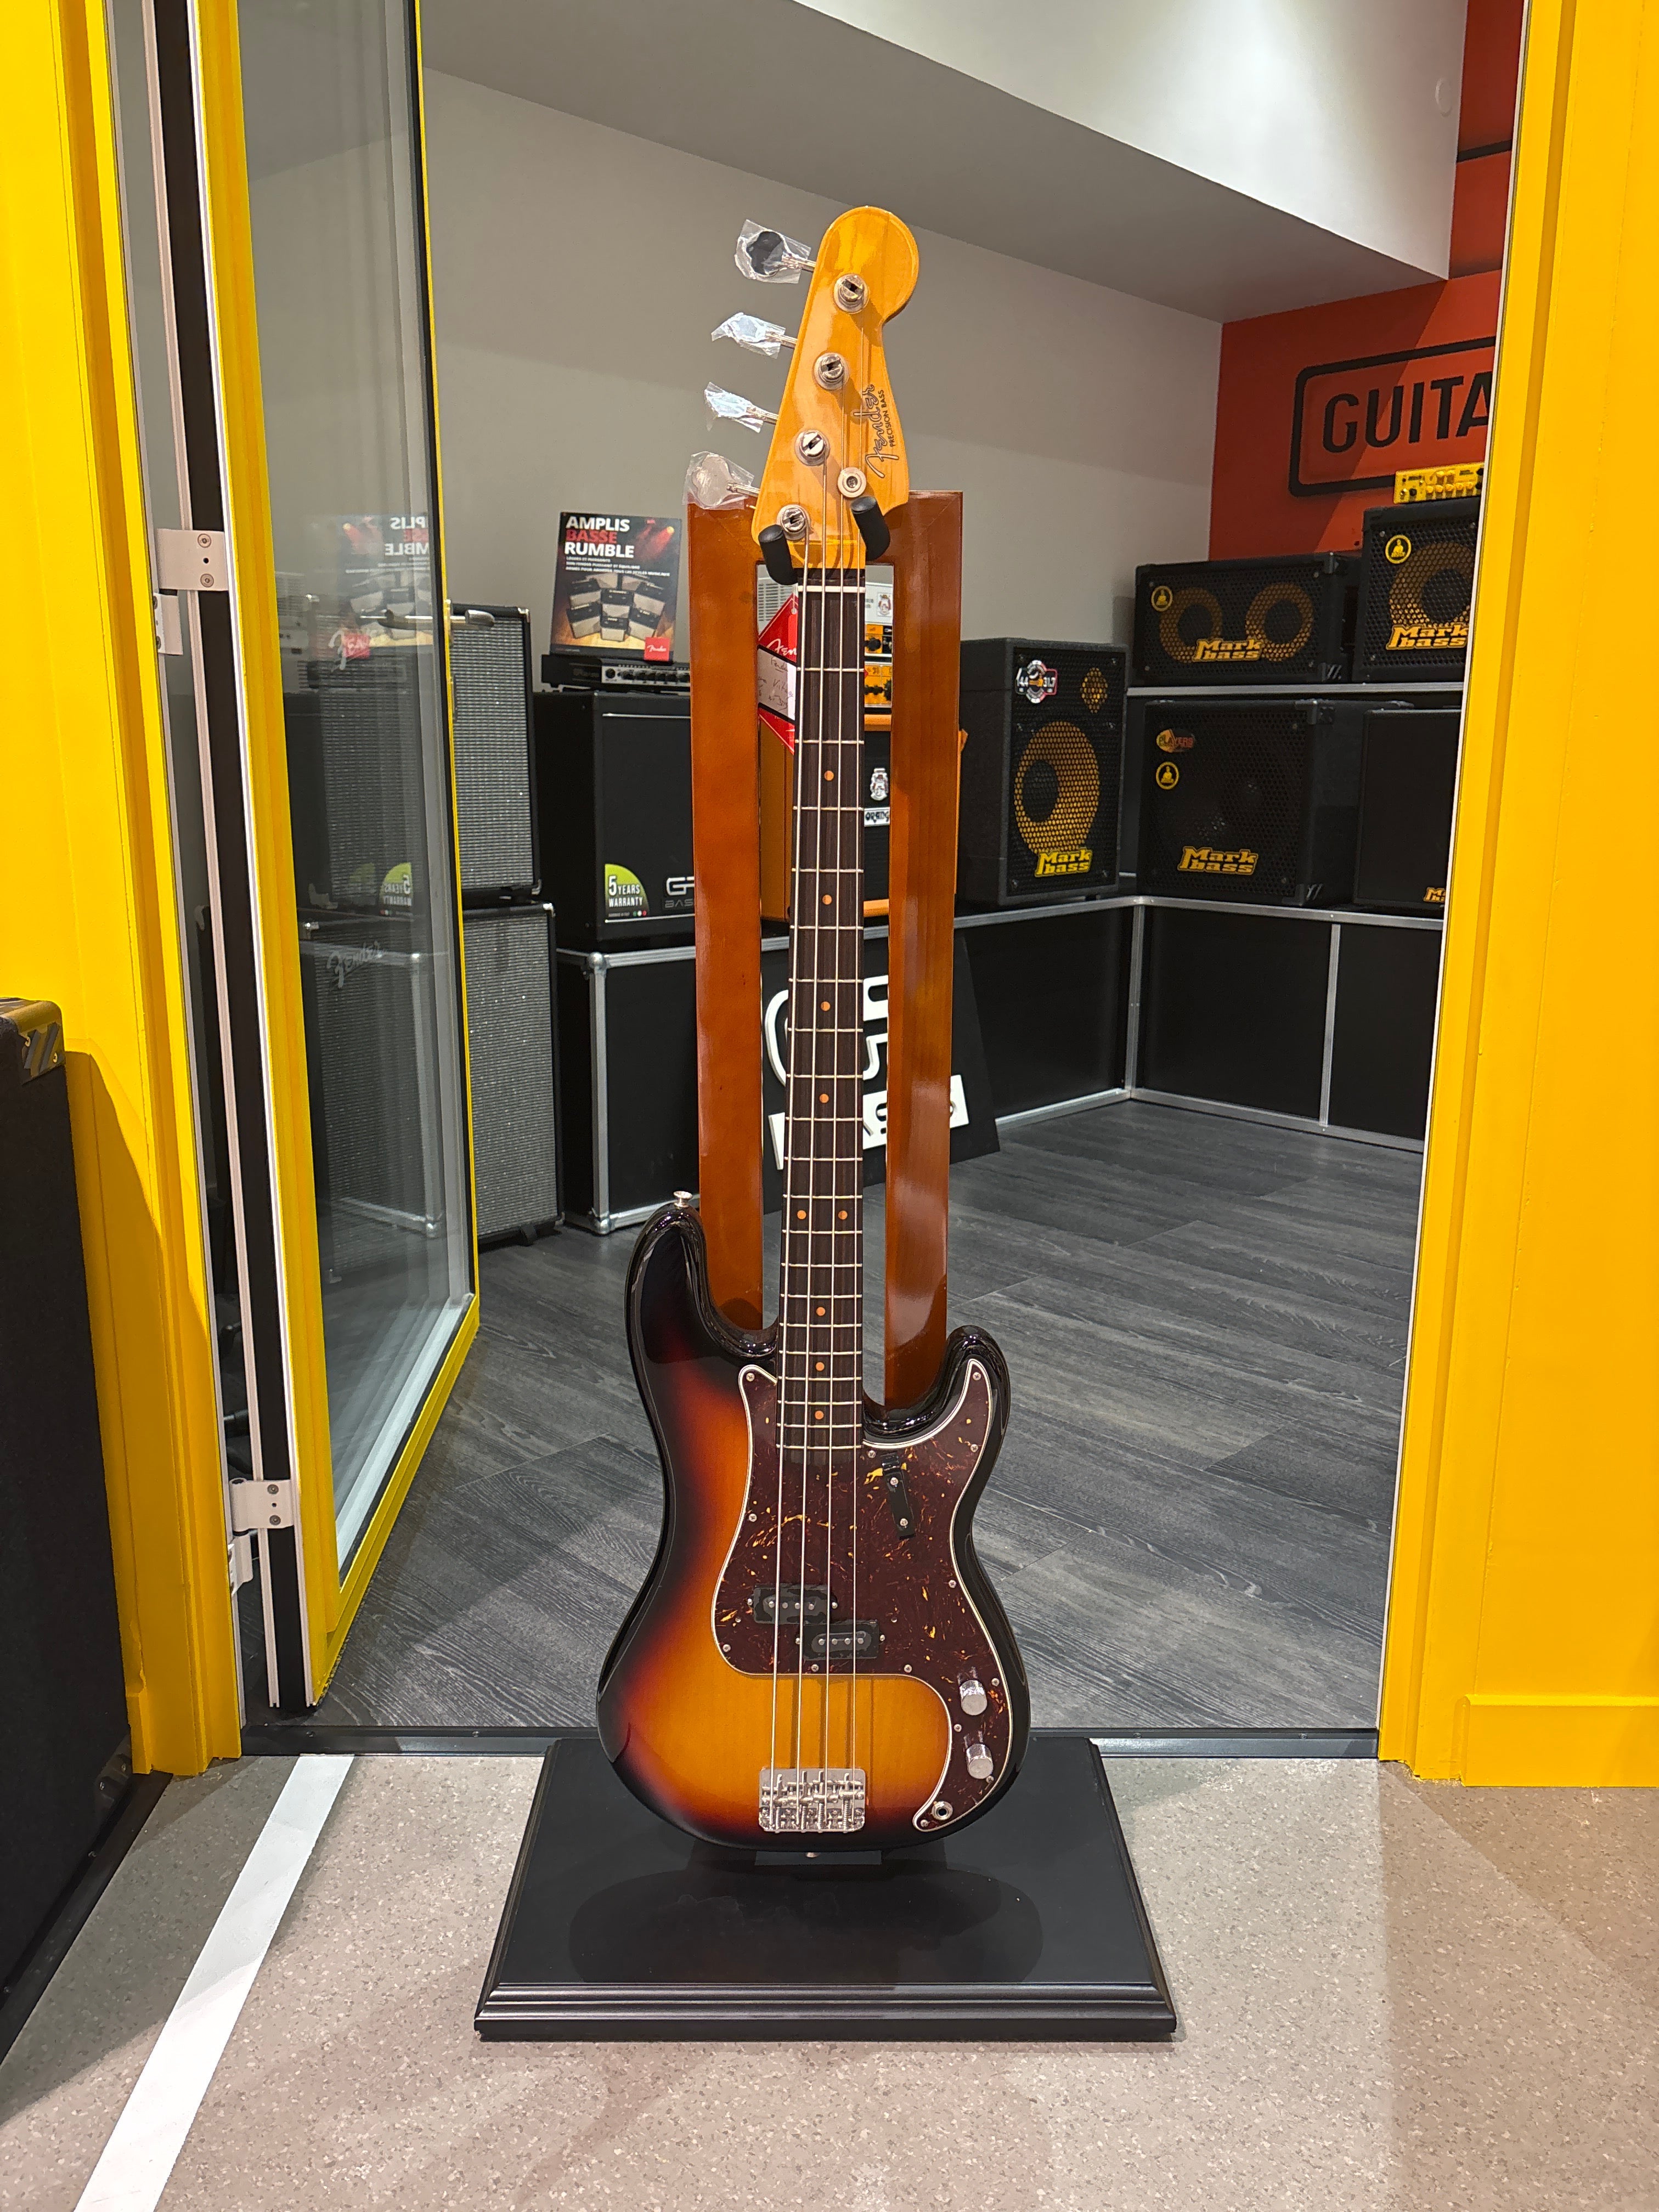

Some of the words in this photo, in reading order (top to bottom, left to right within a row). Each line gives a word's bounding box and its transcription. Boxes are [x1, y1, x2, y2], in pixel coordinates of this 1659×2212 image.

[878, 390, 887, 408] BASS
[1323, 371, 1493, 453] GUITA
[853, 384, 899, 478] Fender
[882, 410, 896, 447] PRECISION
[566, 516, 630, 532] AMPLIS
[566, 529, 617, 544] BASSE
[565, 541, 635, 558] RUMBLE
[1388, 624, 1469, 647] Mark
[1398, 637, 1466, 647] bass
[766, 638, 797, 656] Fen
[1194, 639, 1261, 659] Mark
[1203, 651, 1259, 659] bass
[1036, 849, 1091, 874] Mark
[1180, 848, 1256, 868] Mark
[1189, 859, 1254, 872] bass
[1044, 862, 1089, 874] bass
[608, 876, 617, 896] 5
[618, 884, 640, 894] YEARS
[608, 896, 642, 907] WARRANTY
[665, 899, 693, 908] BAS
